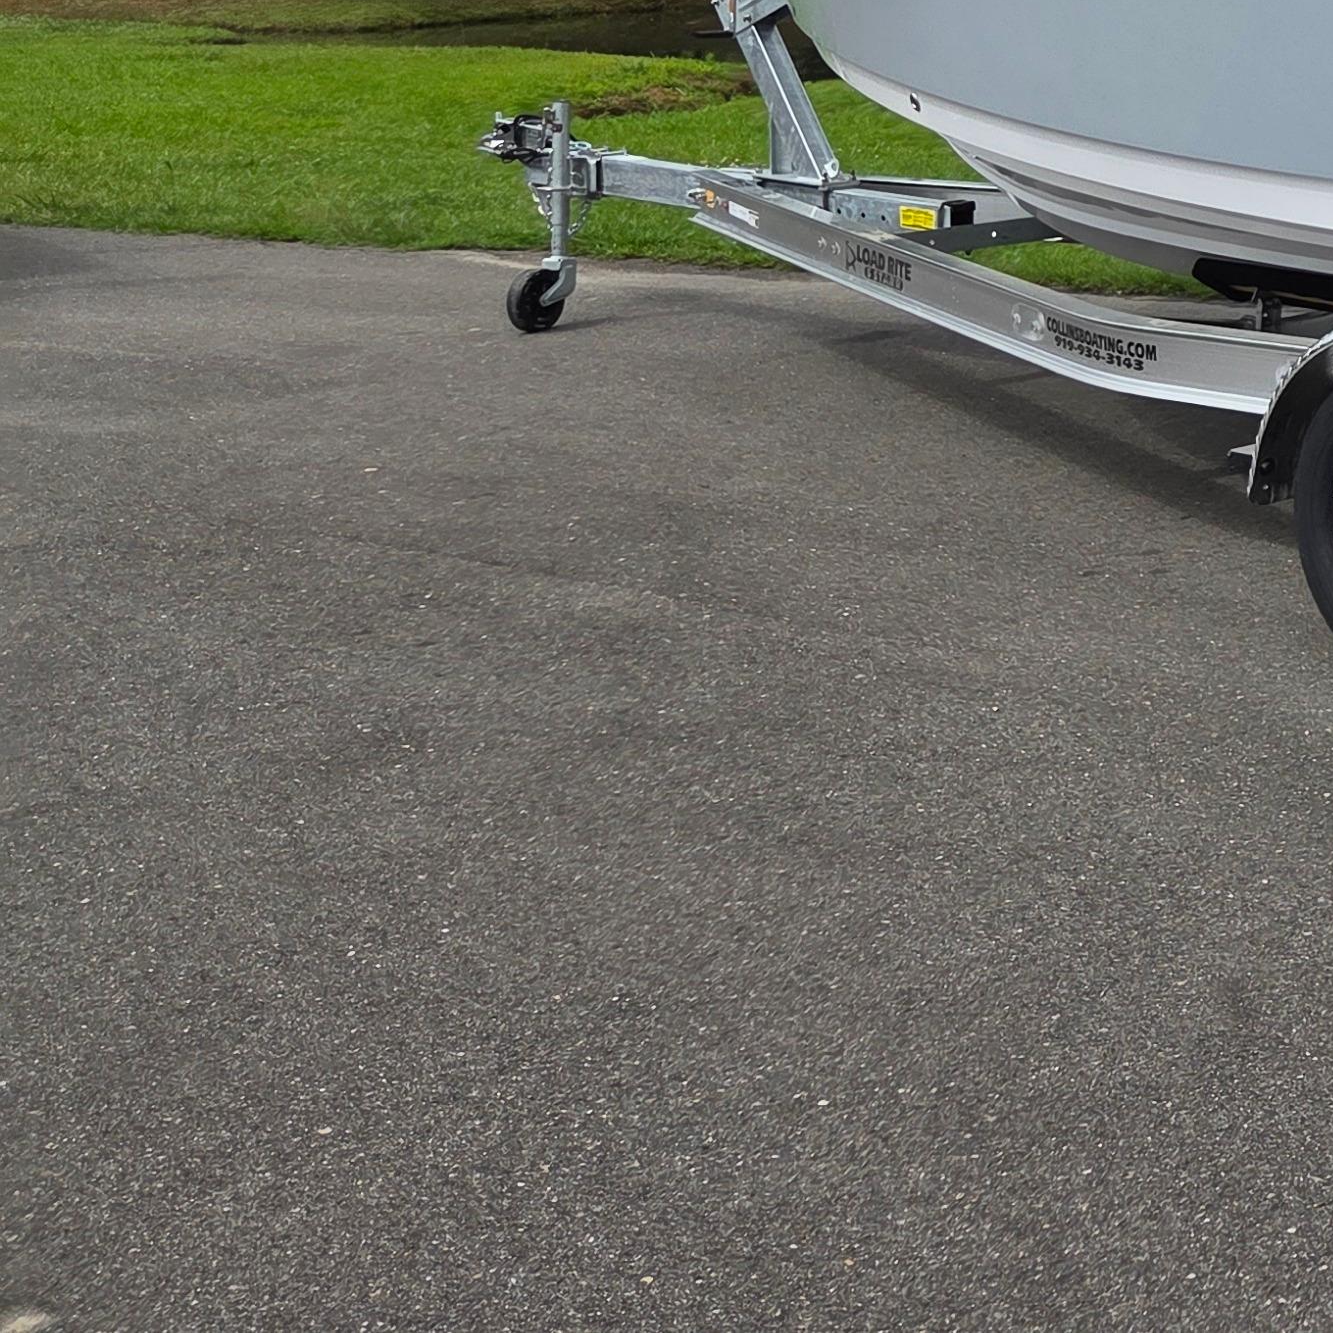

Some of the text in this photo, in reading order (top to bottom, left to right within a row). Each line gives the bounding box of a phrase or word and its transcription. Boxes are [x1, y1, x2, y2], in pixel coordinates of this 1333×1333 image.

[856, 245, 885, 271] LOAD
[887, 256, 912, 281] RITE
[1046, 316, 1157, 361] COLLINSBOATING.COM
[1054, 335, 1145, 371] 919-934-3143
